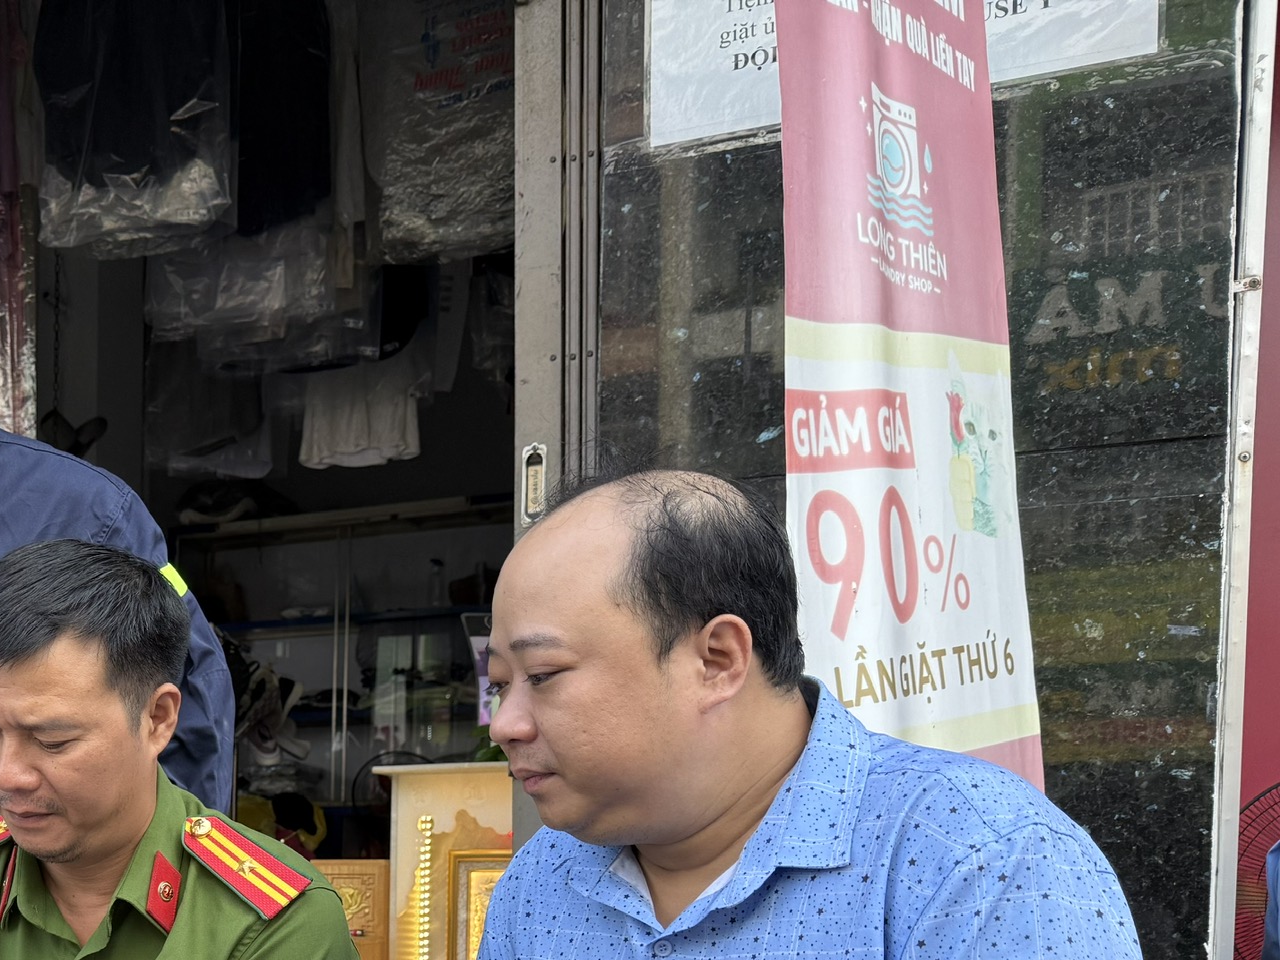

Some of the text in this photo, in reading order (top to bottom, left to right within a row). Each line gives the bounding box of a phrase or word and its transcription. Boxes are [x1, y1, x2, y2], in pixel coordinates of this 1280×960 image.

[720, 22, 757, 48] giặt
[732, 46, 777, 71] ĐỘI
[906, 14, 929, 61] QUÀ
[931, 32, 954, 78] LIỀN
[955, 50, 975, 92] TAY
[857, 212, 948, 281] LONG THIÊN
[908, 275, 933, 293] SHOP
[792, 394, 911, 458] GIẢM GIÁ
[834, 630, 1014, 708] LẦN GIẶT THỨ 6
